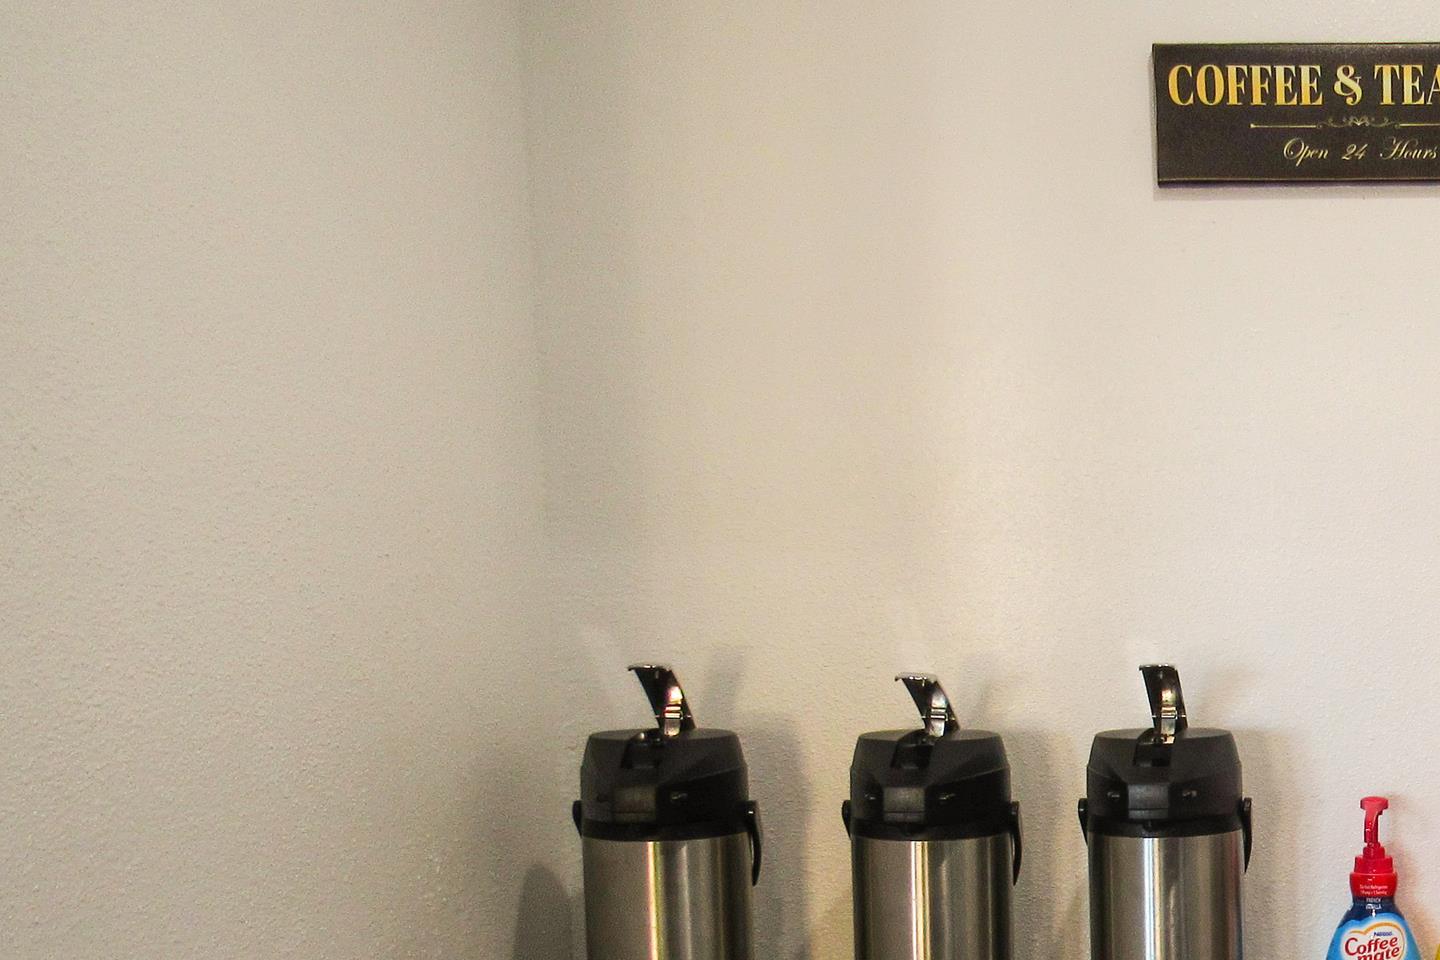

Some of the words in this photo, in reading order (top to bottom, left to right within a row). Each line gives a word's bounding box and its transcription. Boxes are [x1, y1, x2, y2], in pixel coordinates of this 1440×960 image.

[1168, 64, 1323, 106] COFFEE
[1333, 64, 1363, 106] &
[1283, 137, 1329, 167] Open
[1341, 143, 1368, 160] 24
[1379, 136, 1438, 160] Hours
[1344, 936, 1398, 956] Coffee
